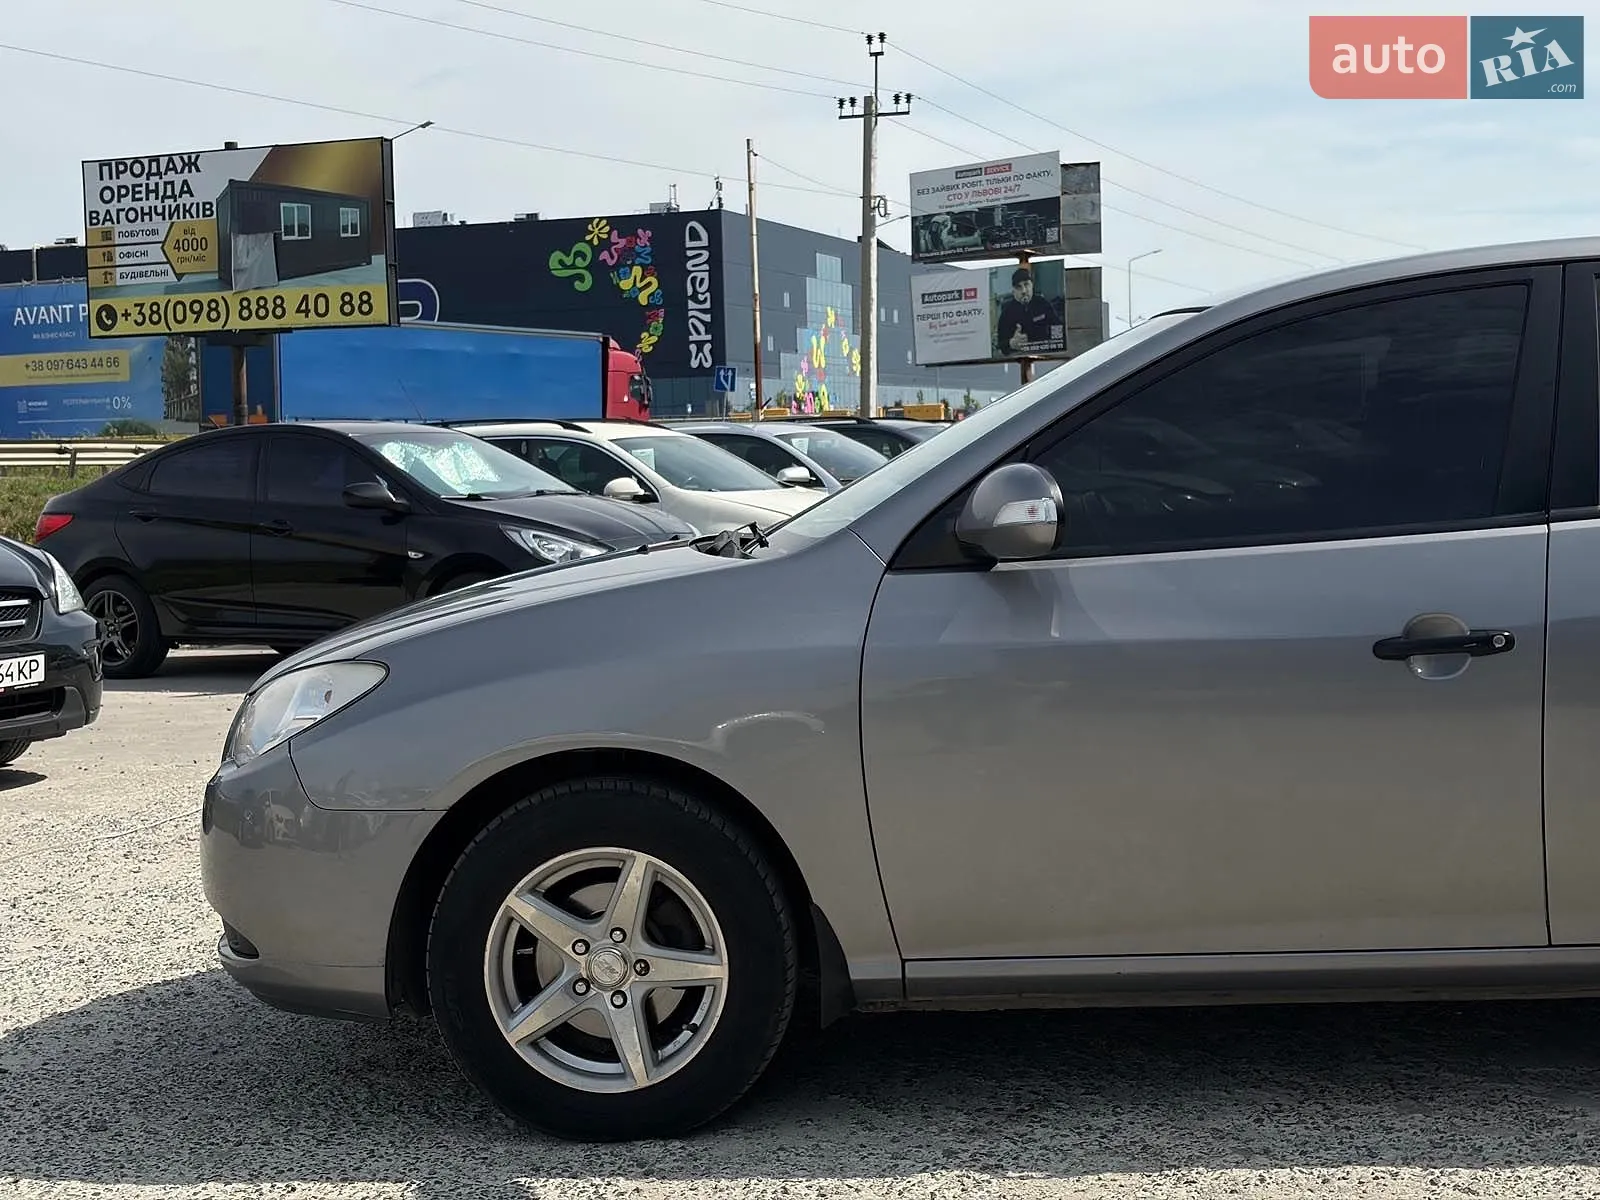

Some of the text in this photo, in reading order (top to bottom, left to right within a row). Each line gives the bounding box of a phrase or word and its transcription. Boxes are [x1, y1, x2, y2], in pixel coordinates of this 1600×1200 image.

[98, 154, 202, 181] ПРОДАЖ
[99, 179, 195, 204] ОРЕНДА
[916, 187, 930, 196] БЕЗ
[1013, 174, 1024, 182] ПО
[946, 193, 963, 202] СТО
[1003, 184, 1021, 194] 24/7
[88, 201, 215, 227] ВАГОНЧИКІВ
[117, 228, 160, 239] ПОБУТОВІ
[183, 227, 196, 236] від
[173, 236, 209, 253] 4000
[118, 249, 149, 260] ОФІСНІ
[176, 253, 206, 264] грн/міс
[119, 268, 169, 281] БУДІВЕЛЬНІ
[924, 290, 961, 303] Autopark
[13, 304, 75, 326] AVANT
[120, 296, 231, 331] +38(098)
[238, 295, 287, 321] 888
[295, 293, 330, 318] 40
[339, 290, 374, 316] 88
[916, 313, 941, 322] ПЕРШІ
[942, 311, 954, 319] ПО
[25, 356, 120, 372] +38 097 643 44 66
[112, 396, 132, 410] 0%
